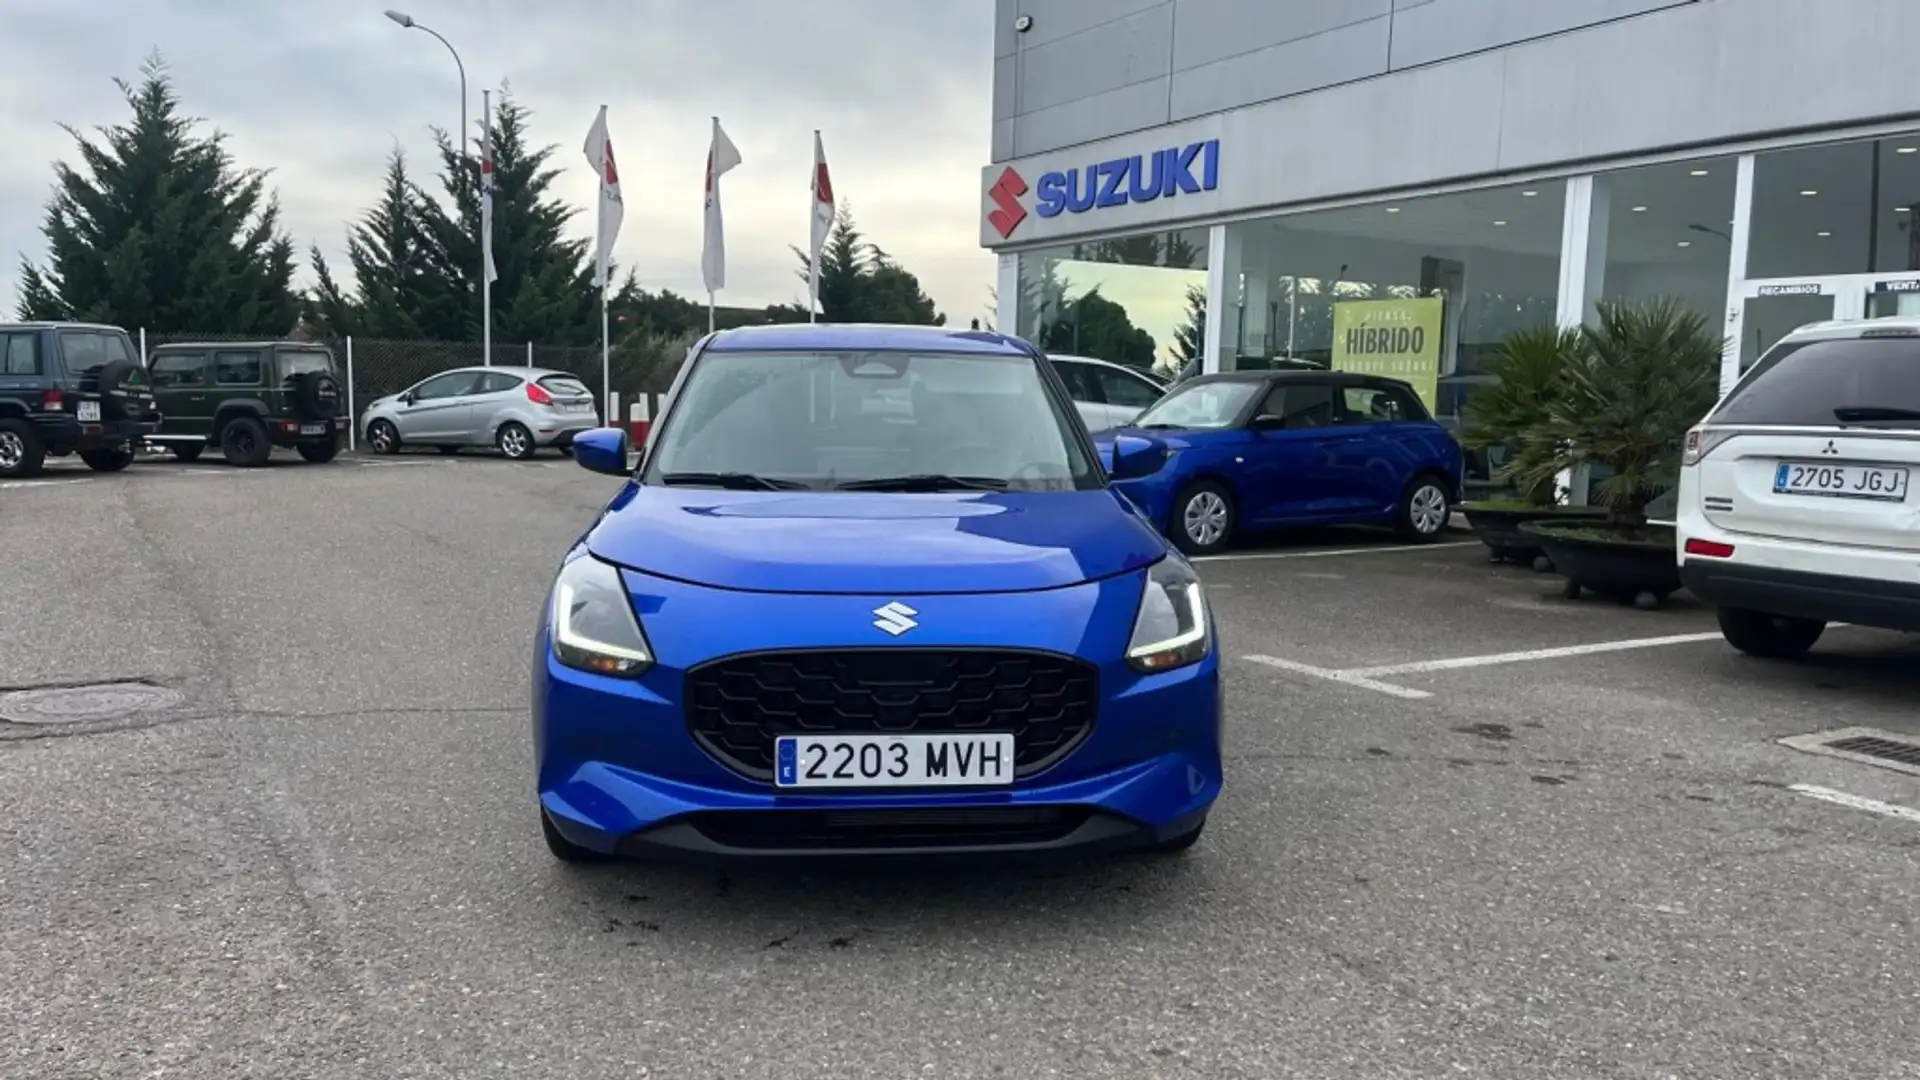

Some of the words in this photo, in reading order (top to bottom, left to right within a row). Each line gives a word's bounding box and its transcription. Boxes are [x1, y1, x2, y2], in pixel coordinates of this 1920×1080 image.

[1035, 139, 1220, 218] SUZUKI
[1760, 284, 1818, 295] RECAMBIOS
[1346, 322, 1424, 354] HÍBRIDO
[1791, 466, 1845, 489] 2705
[1853, 470, 1899, 493] JGJ
[805, 742, 909, 779] 2203
[926, 741, 1001, 778] MVH
